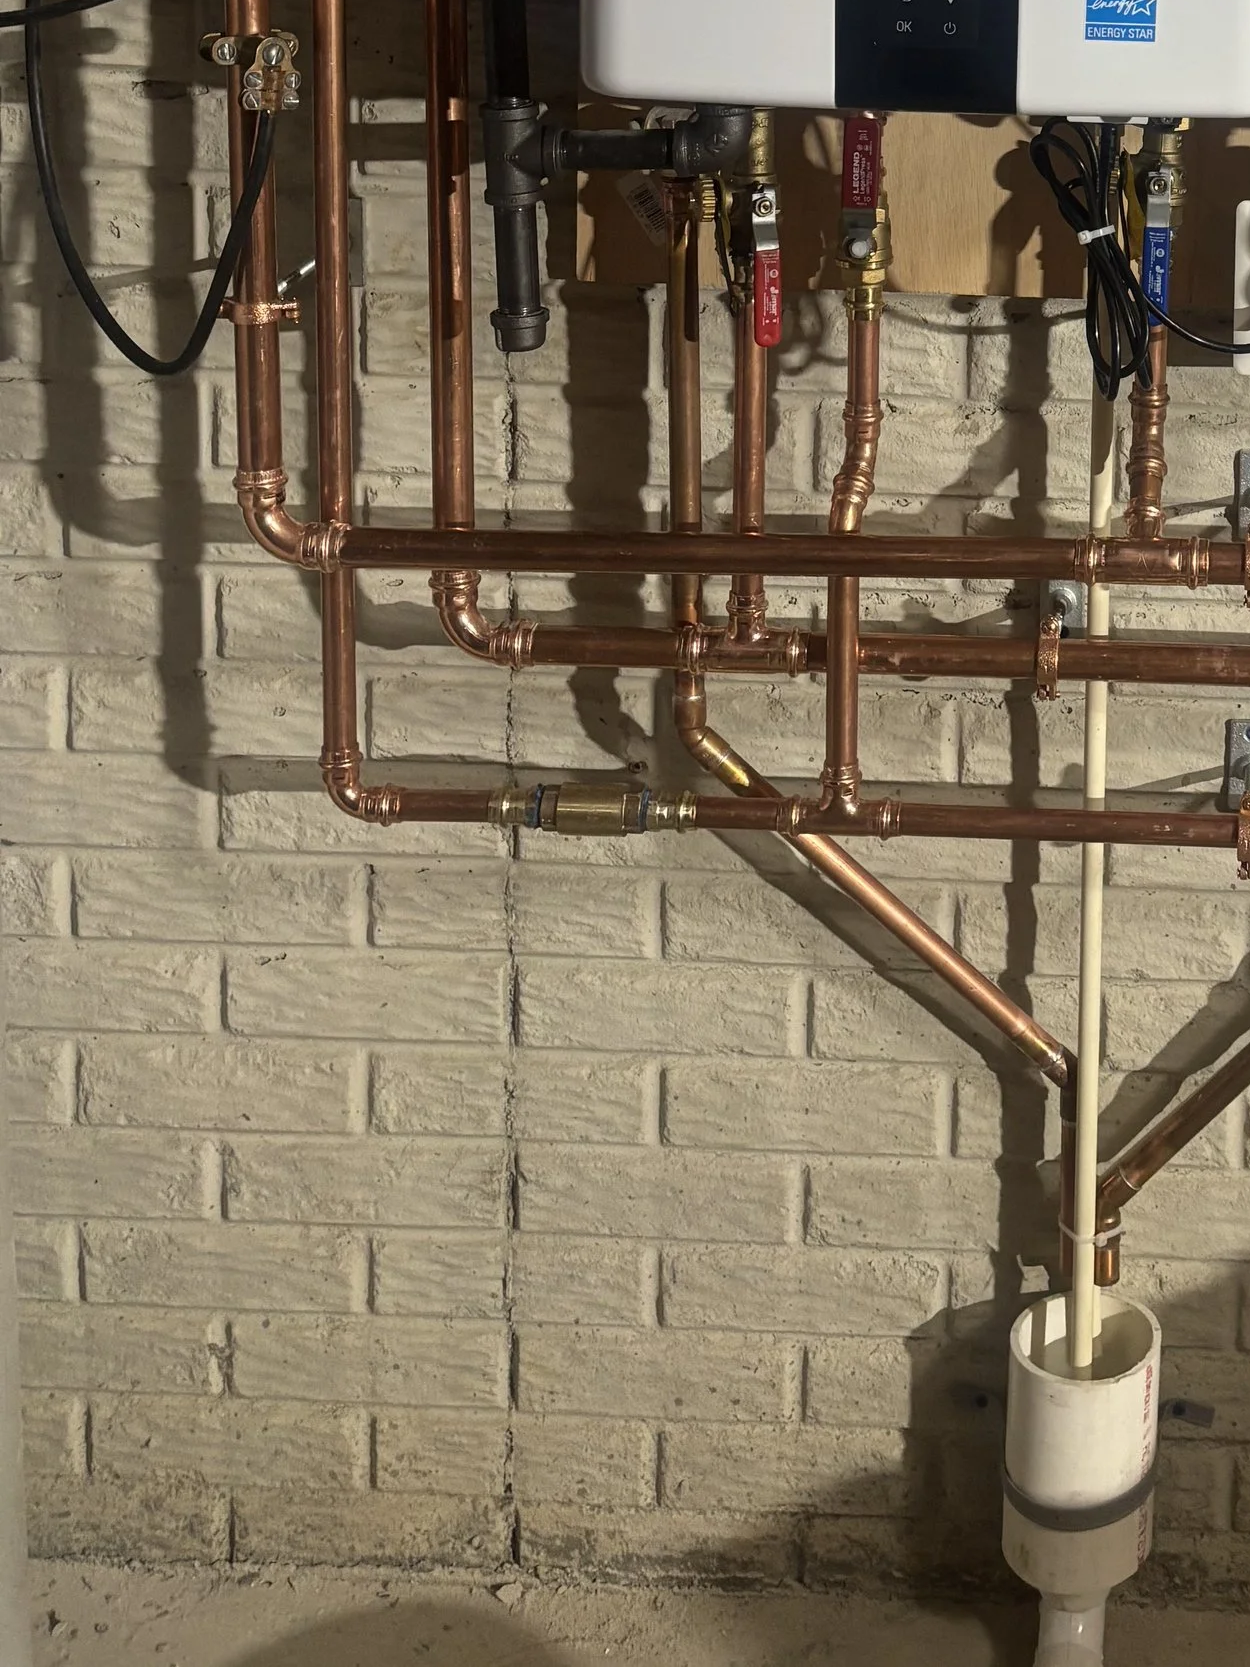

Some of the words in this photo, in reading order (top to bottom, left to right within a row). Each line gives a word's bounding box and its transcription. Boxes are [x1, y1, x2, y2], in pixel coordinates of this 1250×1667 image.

[896, 20, 912, 32] OK
[1087, 26, 1127, 38] ENERGY
[1128, 28, 1154, 39] STAR
[852, 151, 860, 194] LEGEND
